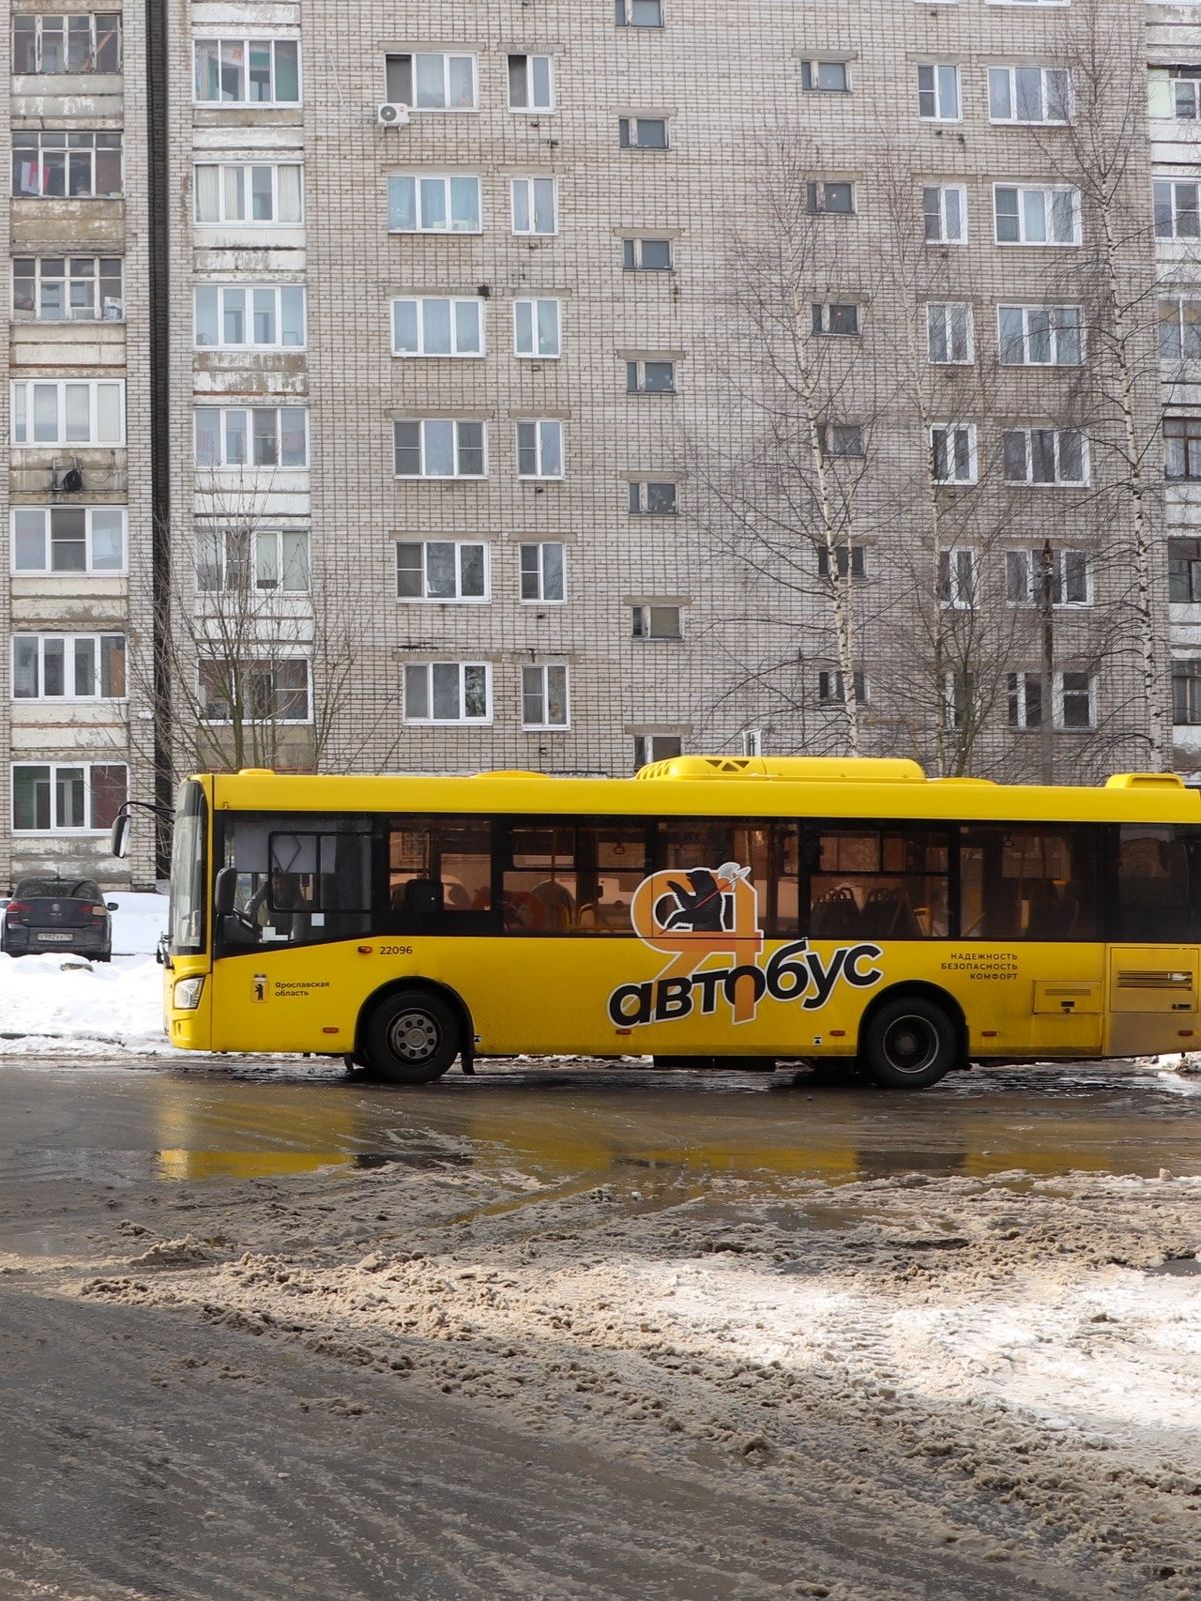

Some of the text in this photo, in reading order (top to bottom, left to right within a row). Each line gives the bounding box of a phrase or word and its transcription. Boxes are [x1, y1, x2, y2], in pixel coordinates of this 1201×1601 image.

[379, 946, 413, 955] 22096
[950, 953, 1018, 961] НАДЕЖНОСТЬ
[275, 981, 330, 989] Ярославская
[607, 937, 883, 1027] автобус
[275, 989, 309, 997] область
